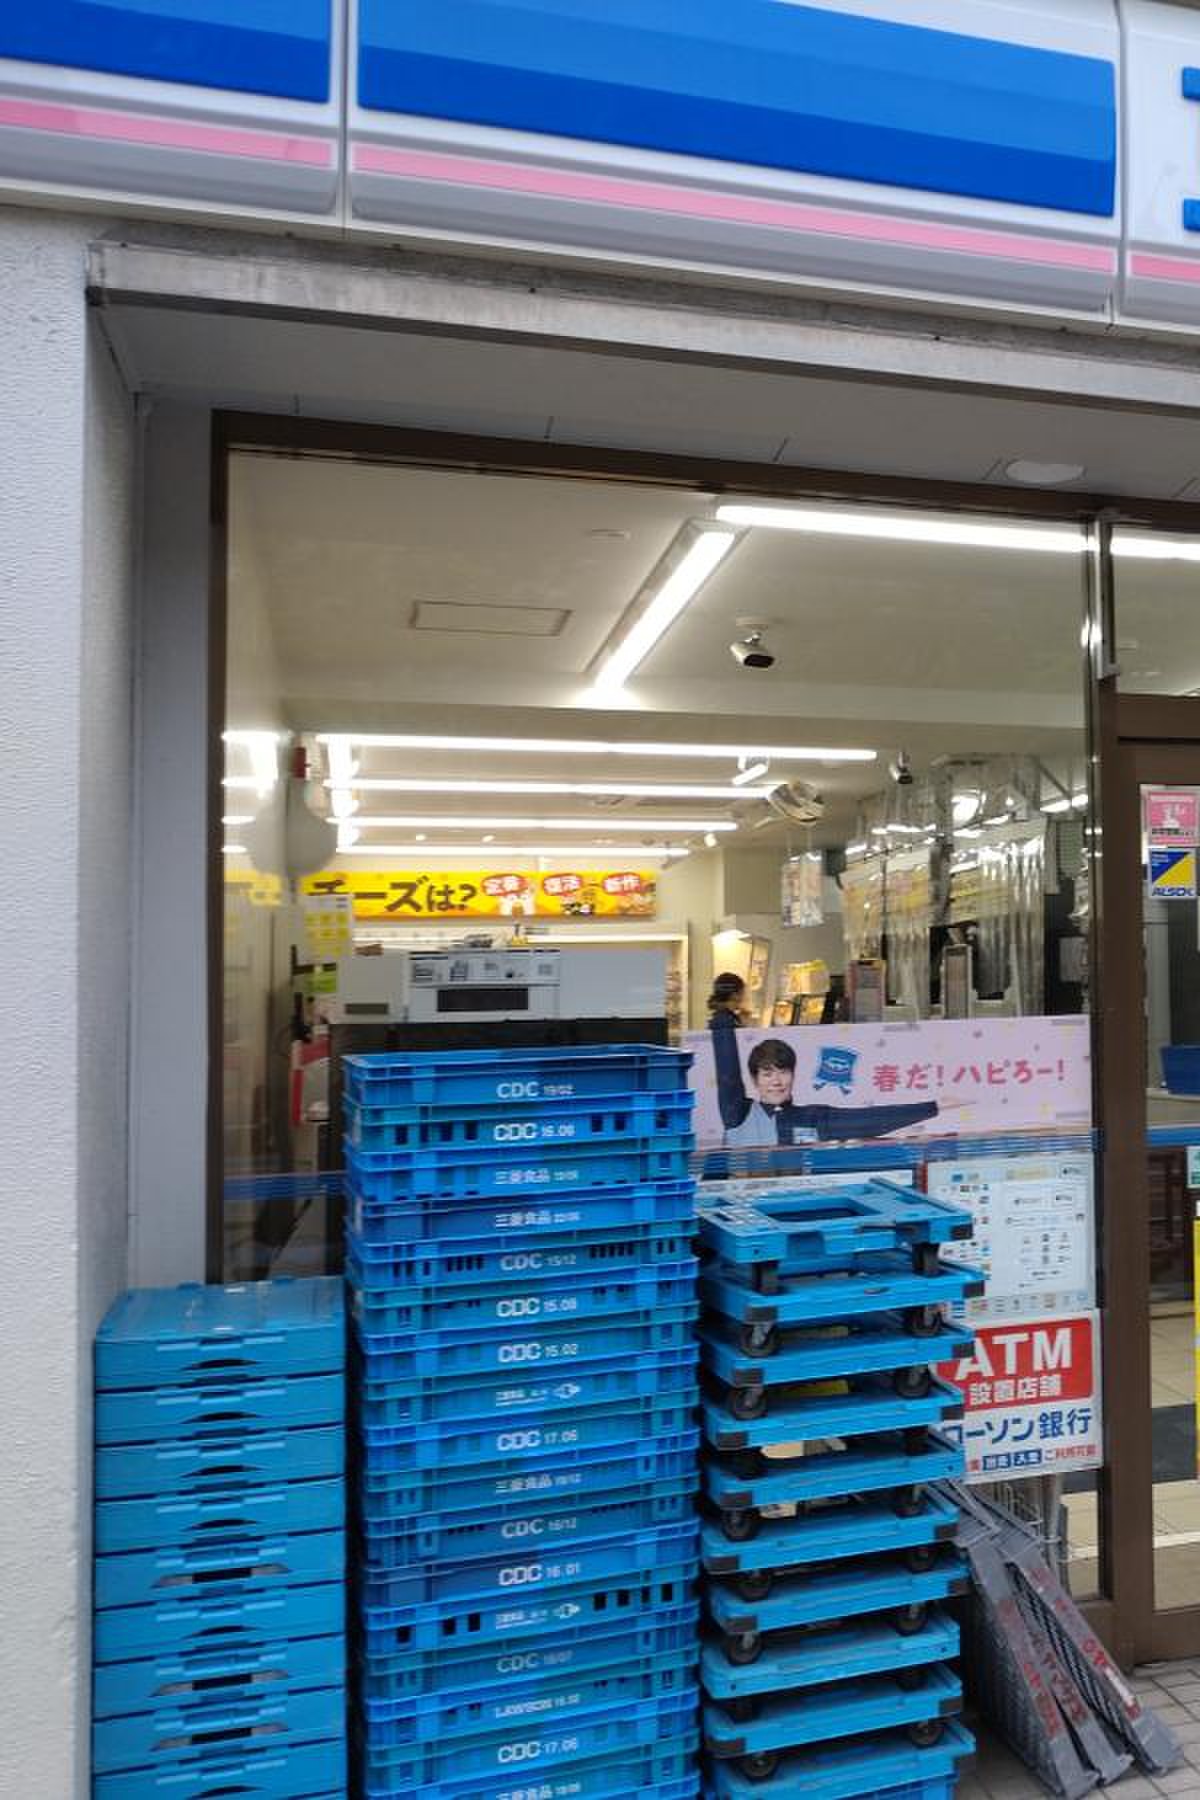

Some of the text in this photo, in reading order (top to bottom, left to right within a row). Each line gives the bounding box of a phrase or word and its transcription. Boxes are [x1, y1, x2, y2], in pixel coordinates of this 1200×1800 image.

[497, 1082, 539, 1098] CDC
[494, 1123, 538, 1140] CDC
[501, 1254, 542, 1270] CDC
[497, 1298, 540, 1317] CDC
[498, 1343, 542, 1362] CDC
[954, 1328, 1072, 1381] ATM
[497, 1432, 541, 1451] CDC
[502, 1519, 544, 1538] CDC
[499, 1565, 543, 1586] CDC
[497, 1653, 539, 1672] CDC
[498, 1742, 540, 1763] CDC
